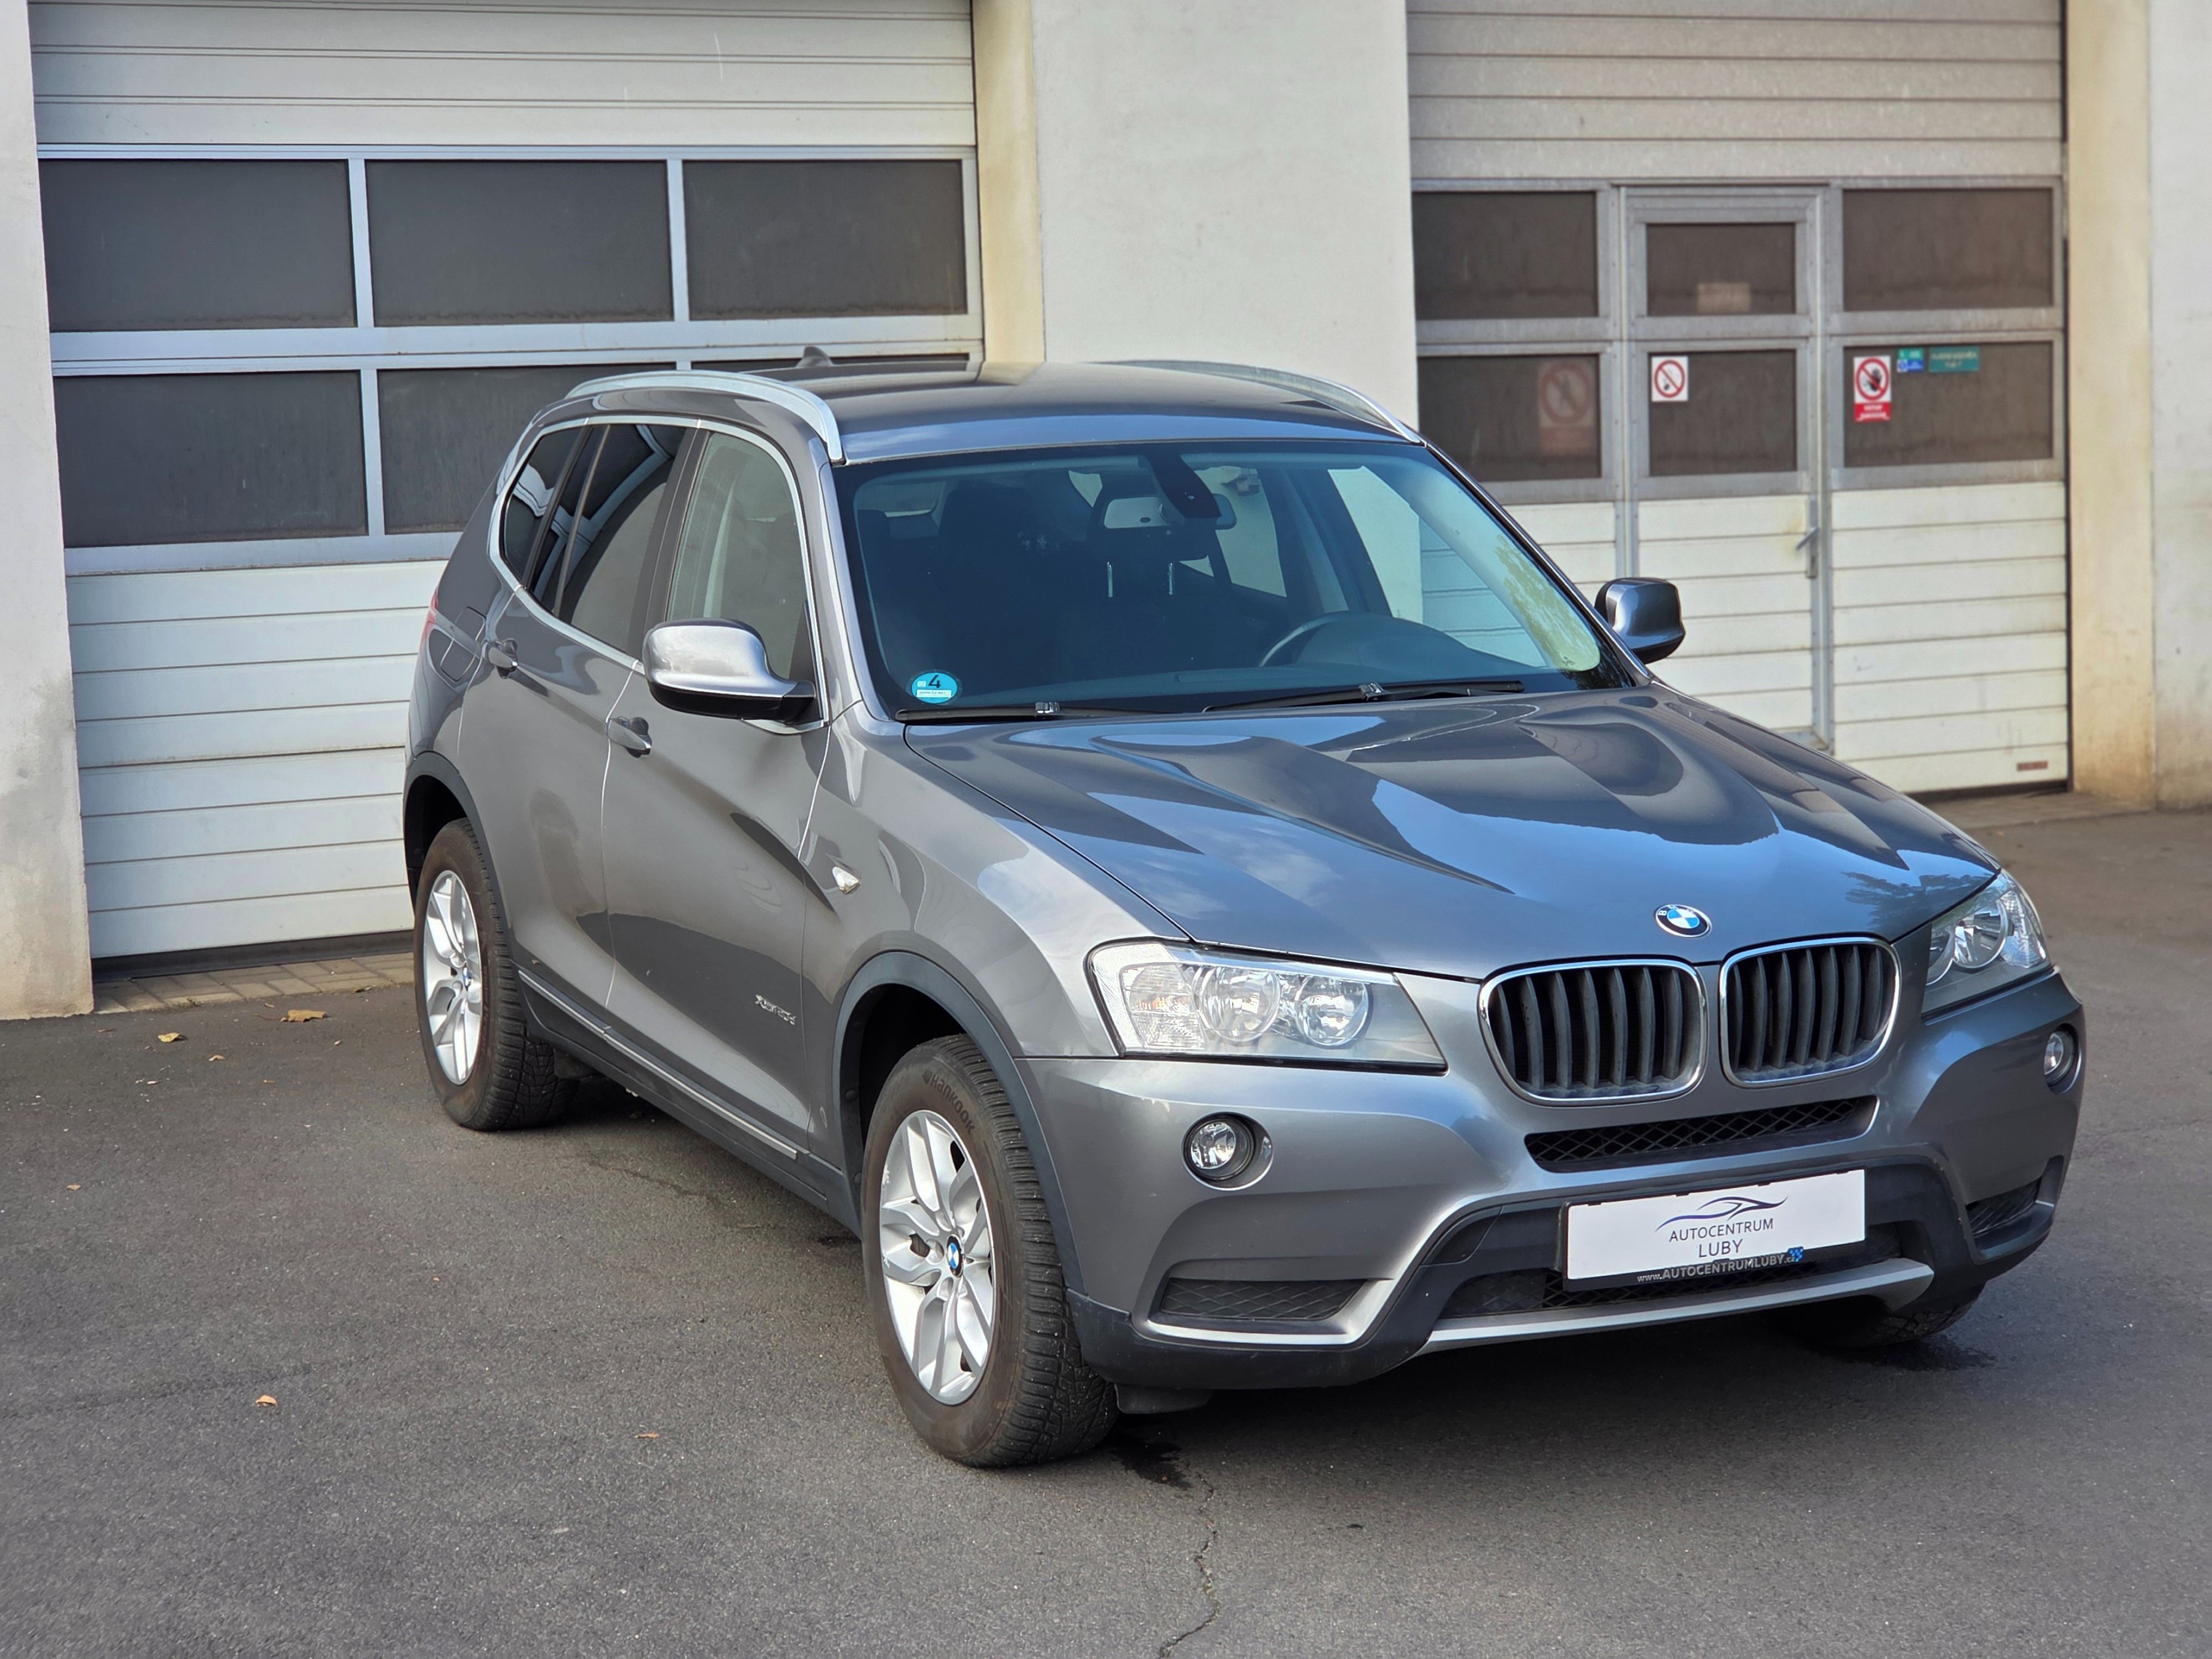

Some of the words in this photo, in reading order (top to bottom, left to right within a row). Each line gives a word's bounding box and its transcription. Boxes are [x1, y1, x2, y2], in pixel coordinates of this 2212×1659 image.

[928, 674, 941, 688] 4
[1669, 1218, 1773, 1242] AUTOCENTRUM
[1698, 1239, 1743, 1258] LUBY
